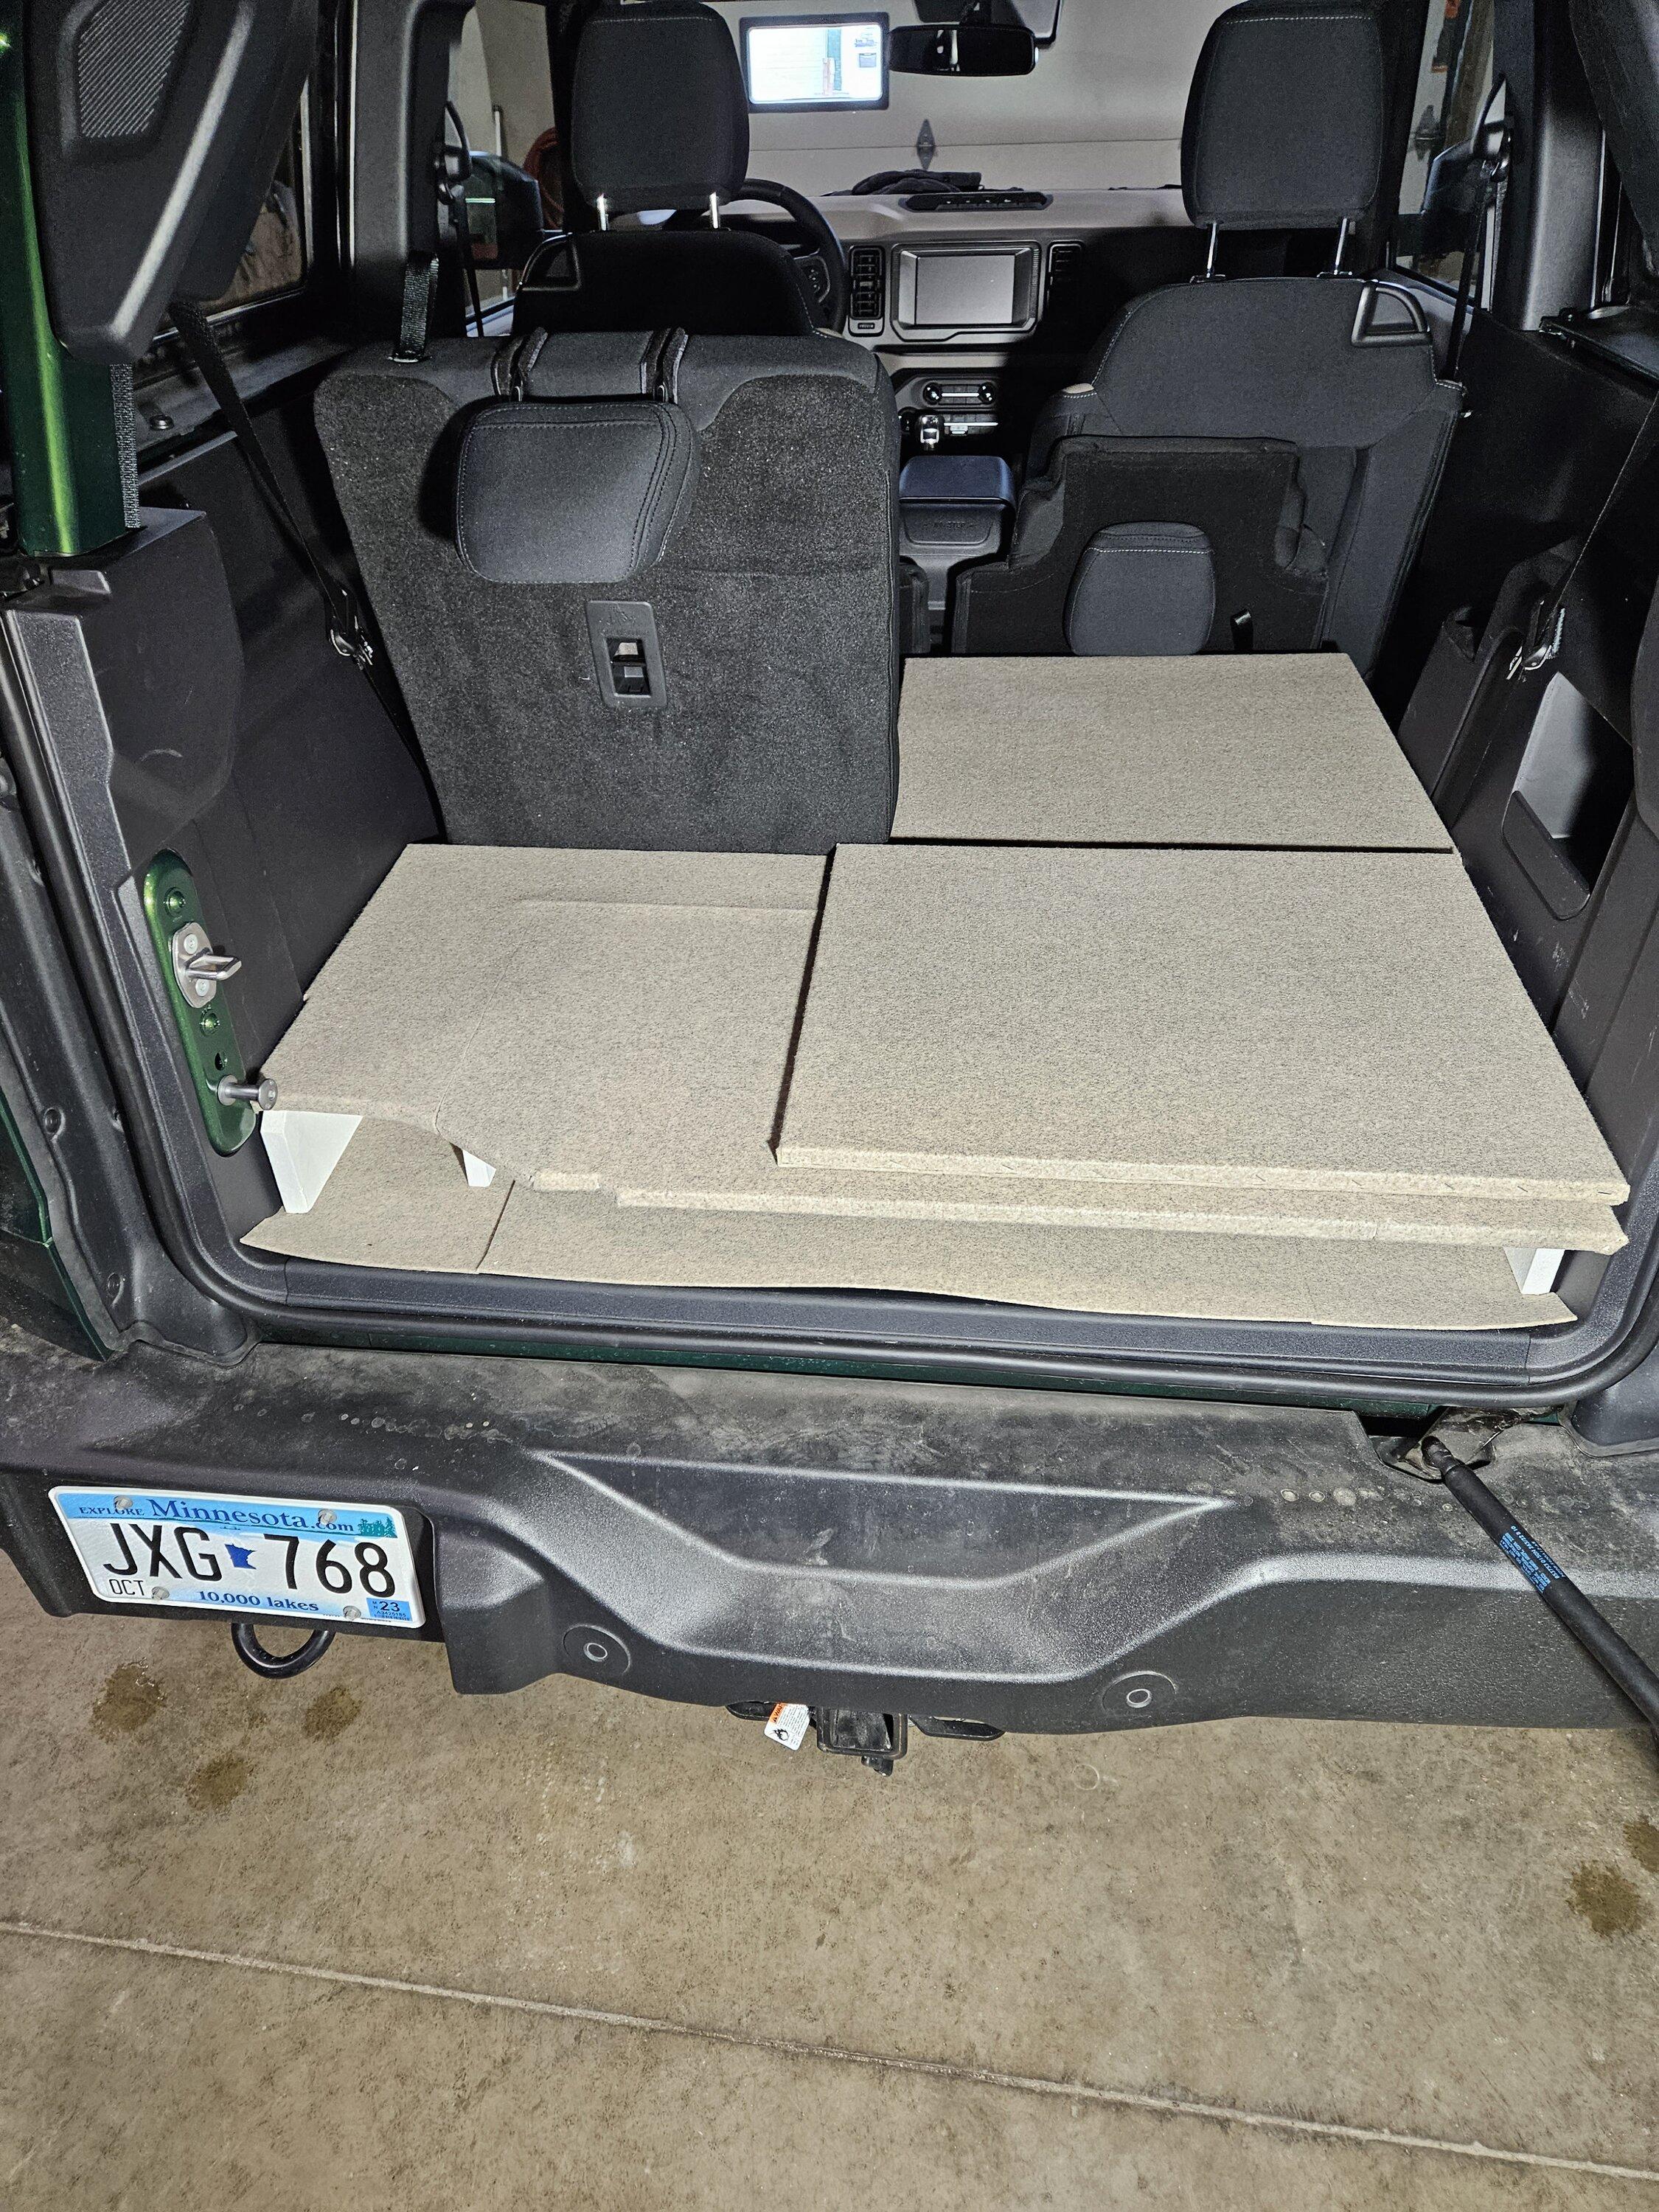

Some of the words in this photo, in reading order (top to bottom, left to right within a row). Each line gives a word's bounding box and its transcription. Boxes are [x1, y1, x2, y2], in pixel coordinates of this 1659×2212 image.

[79, 1506, 145, 1516] EXPLORE
[103, 1523, 223, 1582] JXG
[263, 1533, 396, 1598] 768
[108, 1579, 146, 1596] OCT
[197, 1590, 261, 1606] 10,000
[266, 1596, 319, 1611] lakes
[378, 1601, 400, 1612] 23
